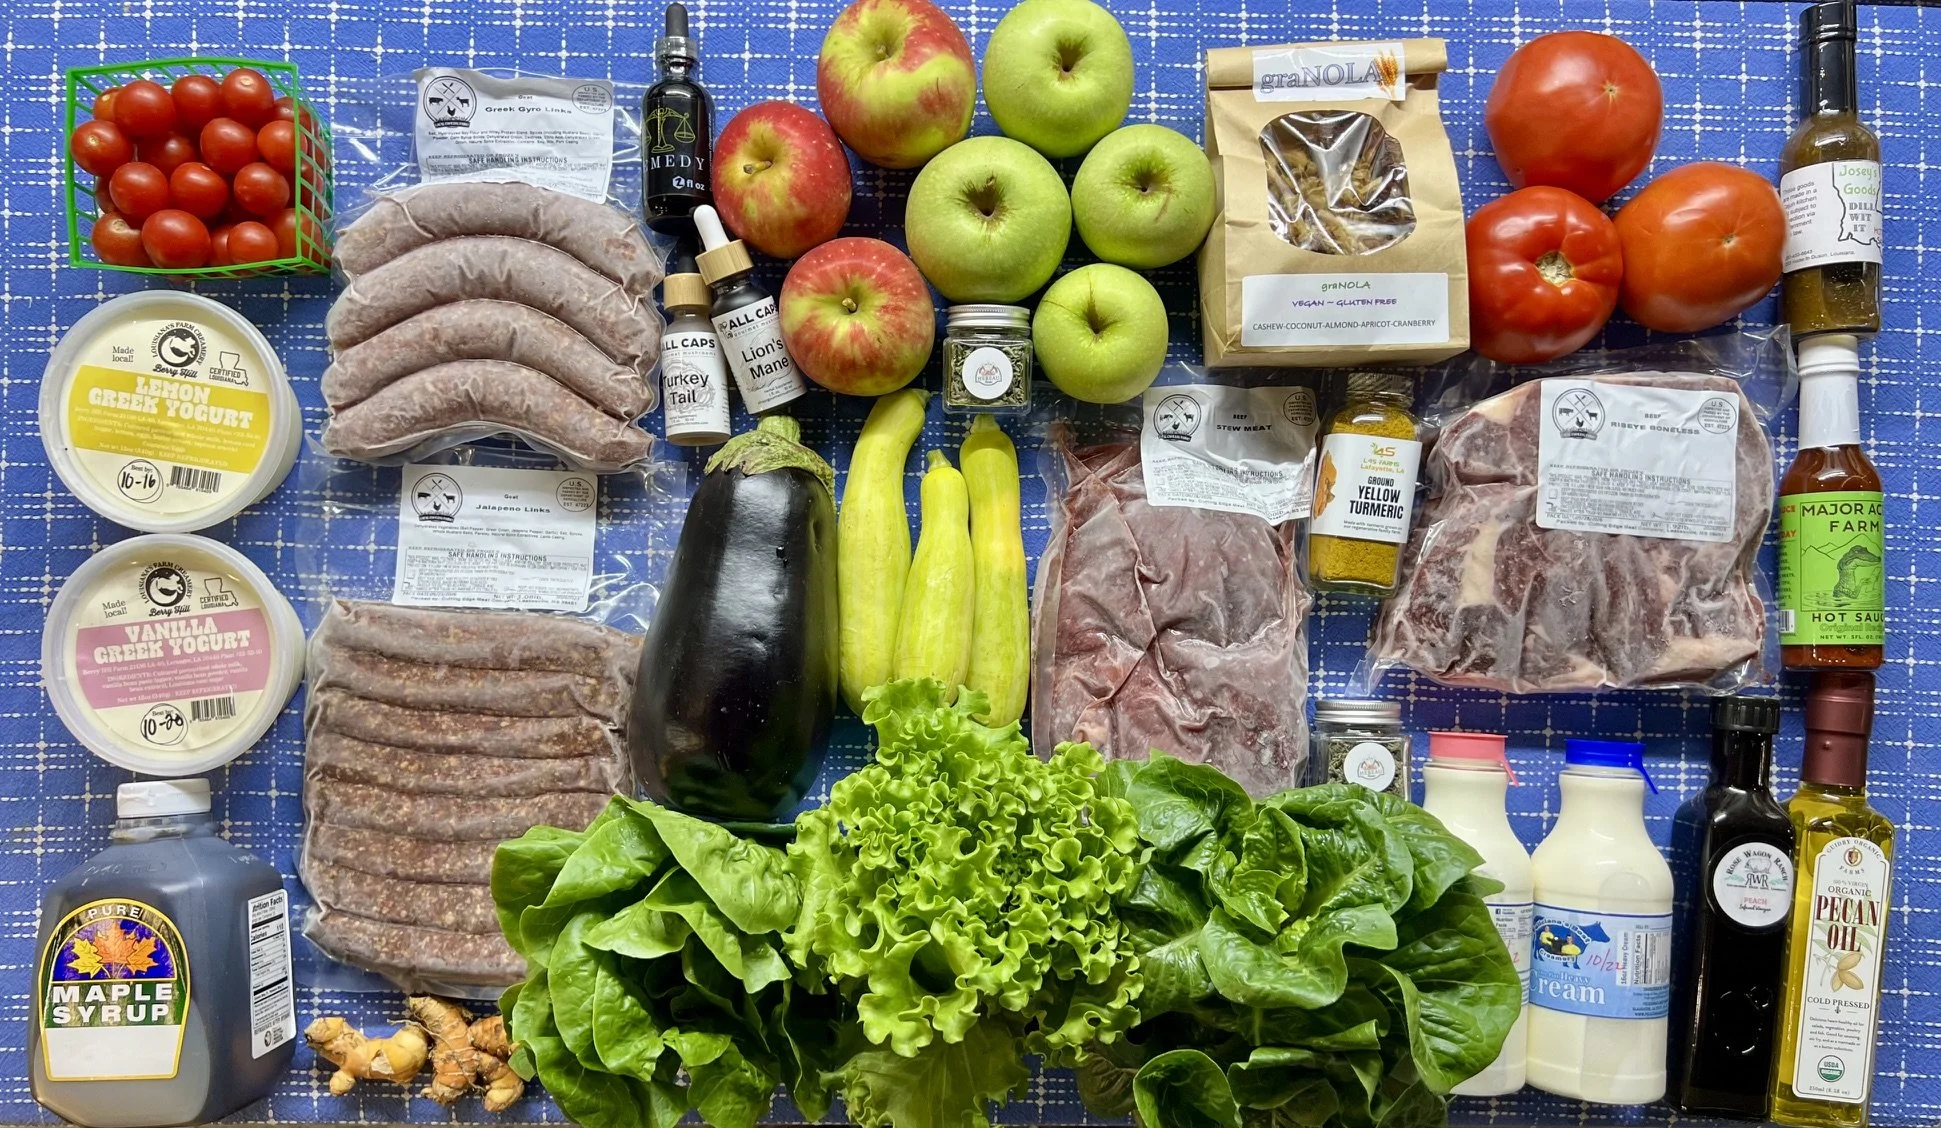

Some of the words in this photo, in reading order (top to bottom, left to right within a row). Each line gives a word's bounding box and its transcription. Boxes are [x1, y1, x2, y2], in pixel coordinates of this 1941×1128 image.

[1260, 59, 1382, 93] graNOLA
[518, 106, 542, 114] Gyro
[545, 106, 572, 114] Links
[1839, 165, 1877, 180] Josey's
[695, 182, 705, 191] oz
[1843, 183, 1876, 196] Goods
[1849, 202, 1876, 211] DILL
[1849, 213, 1872, 222] WIT
[1853, 224, 1867, 232] IT
[1321, 280, 1371, 292] graNOLA
[1292, 299, 1325, 308] VEGAN
[1336, 298, 1374, 307] GLUTEN
[1374, 298, 1397, 306] FREE
[729, 314, 755, 330] ALL
[1252, 318, 1436, 331] CASHEW-COCONUT-ALMOND-APRICOT-CRANBERRY
[112, 346, 135, 354] Made
[150, 322, 175, 358] LOUISIANA'S
[176, 322, 195, 331] FARM
[194, 328, 207, 366] CREAMERY
[681, 338, 716, 349] CAPS
[742, 338, 784, 363] Lion's
[112, 354, 134, 363] local!
[152, 364, 178, 377] Berry
[178, 369, 198, 378] Hill
[209, 367, 240, 378] CERTIFIED
[749, 356, 790, 380] Mane
[664, 372, 710, 390] Turkey
[136, 376, 210, 404] LEMON
[670, 390, 698, 405] Tail
[88, 387, 158, 414] GREEK
[166, 400, 254, 429] YOGURT
[1216, 424, 1241, 432] STEW
[1244, 424, 1272, 432] MEAT
[1611, 422, 1646, 430] RIBEYE
[1650, 425, 1700, 434] BONELESS
[120, 471, 156, 490] 10-16
[1368, 476, 1395, 488] GROUND
[1591, 470, 1608, 478] SAFE
[1609, 472, 1644, 481] HANDLING
[1645, 474, 1691, 485] INSTRUCTIONS
[1358, 485, 1401, 504] YELLOW
[476, 504, 522, 512] Jalapeno
[524, 506, 551, 514] Links
[1350, 500, 1404, 520] TURMERIC
[1802, 503, 1864, 517] MAJOR
[1830, 520, 1880, 532] FARM
[466, 552, 498, 560] HANDLING
[500, 554, 547, 562] INSTRUCTIONS
[138, 565, 154, 604] LOUISIANA'S
[153, 562, 174, 570] FARM
[174, 564, 193, 600] CREAMERY
[102, 600, 126, 610] Made
[200, 594, 229, 604] CERTIFIED
[104, 607, 128, 618] local!
[148, 607, 173, 618] Berry
[174, 604, 190, 616] Hill
[1812, 612, 1847, 622] HOT
[1856, 612, 1883, 622] SAUC
[124, 617, 218, 643] VANILLA
[1820, 623, 1864, 634] Original
[94, 641, 164, 665] GREEK
[168, 630, 251, 656] YOGURT
[1826, 839, 1851, 854] GUIDRY
[1854, 840, 1882, 859] ORGANIC
[1726, 856, 1742, 875] ROSE
[1744, 849, 1772, 859] WAGON
[1774, 857, 1788, 880] RANCH
[1839, 864, 1865, 875] FARMS
[1828, 886, 1872, 897] ORGANIC
[1744, 896, 1768, 905] PEACH
[88, 904, 141, 918] PURE
[1816, 895, 1880, 926] PECAN
[1827, 924, 1862, 952] OIL
[1538, 948, 1576, 962] Creamery
[1560, 972, 1591, 984] Heavy
[52, 982, 172, 1004] MAPLE
[1530, 969, 1606, 1004] Cream
[1807, 996, 1831, 1005] COLD
[1832, 999, 1870, 1010] PRESSED
[52, 1004, 170, 1024] SYRUP
